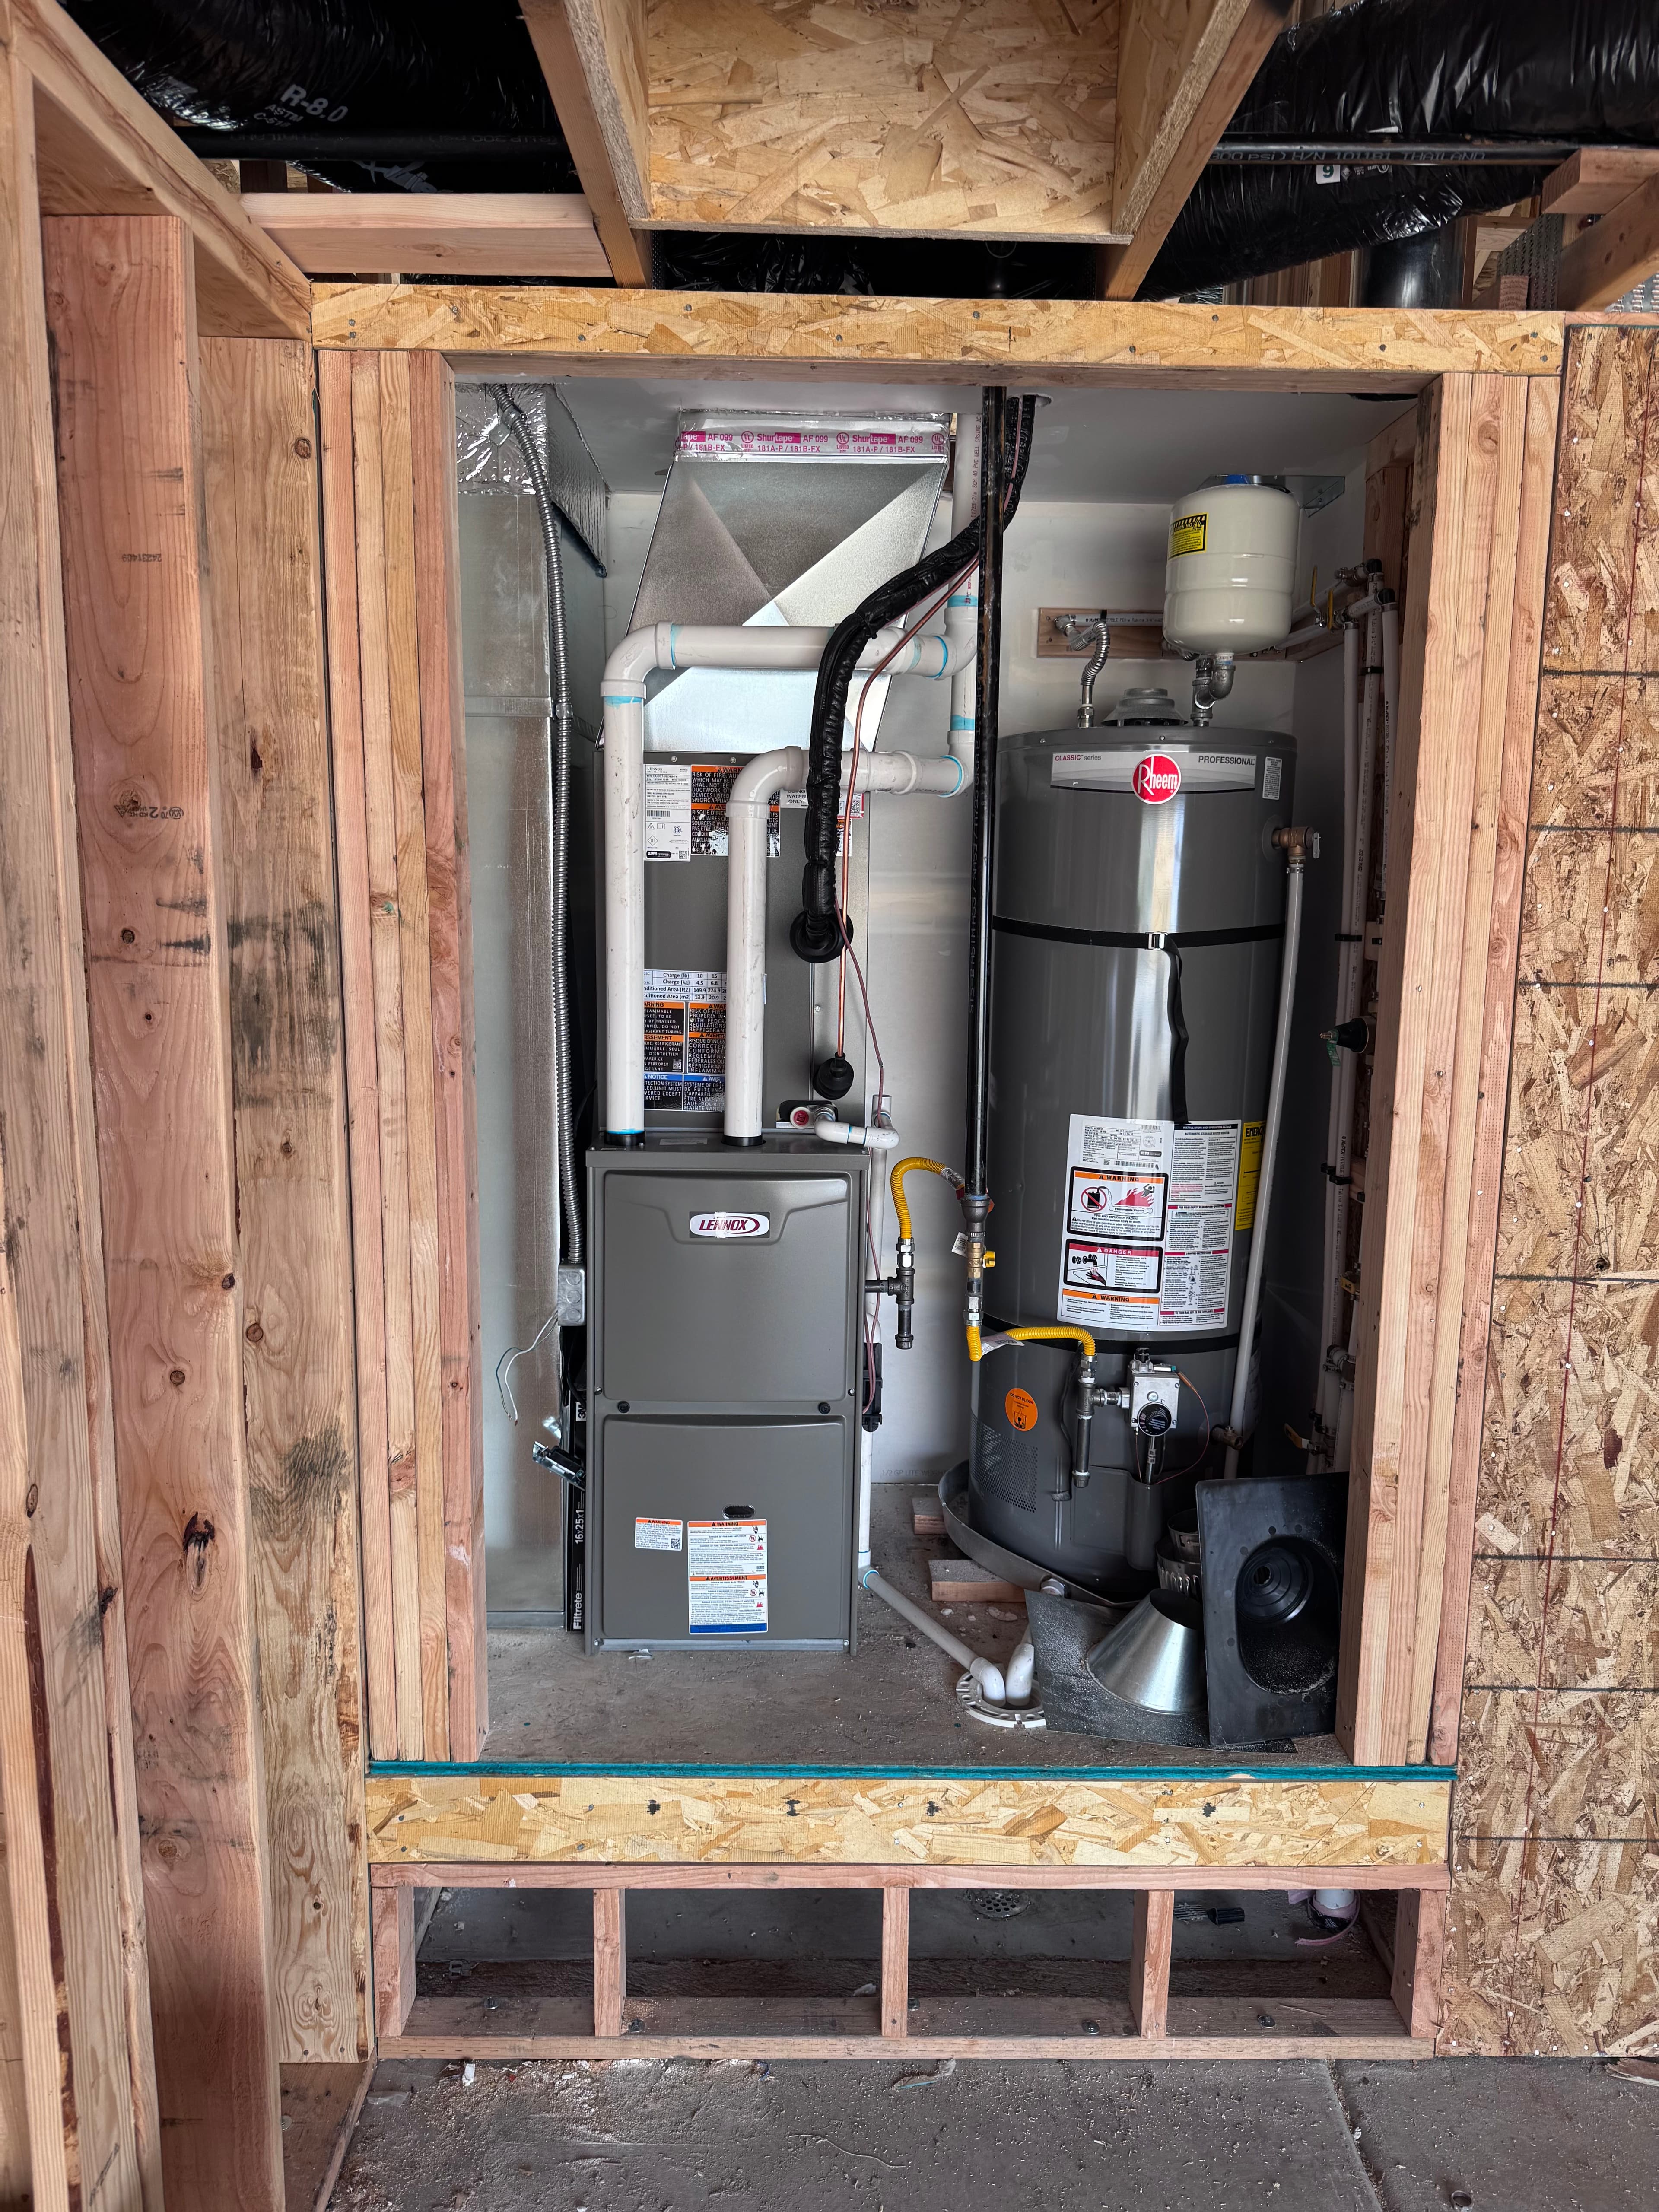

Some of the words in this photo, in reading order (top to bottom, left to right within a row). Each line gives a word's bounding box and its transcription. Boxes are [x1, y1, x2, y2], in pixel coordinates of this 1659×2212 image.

[280, 84, 348, 122] R-8.0
[264, 104, 304, 122] ASTM
[1210, 152, 1243, 160] 300
[1291, 152, 1325, 160] H/N
[1404, 152, 1485, 160] THAILAND
[757, 433, 795, 442] Shurtape
[852, 433, 889, 444] Shurtape
[1198, 756, 1255, 766] PROFESSIONAL
[1138, 756, 1177, 796] Rheem
[149, 807, 159, 819] 2
[699, 1219, 749, 1231] LENNOX
[575, 1510, 584, 1545] 16x25x1
[573, 1592, 582, 1630] Filtrete
